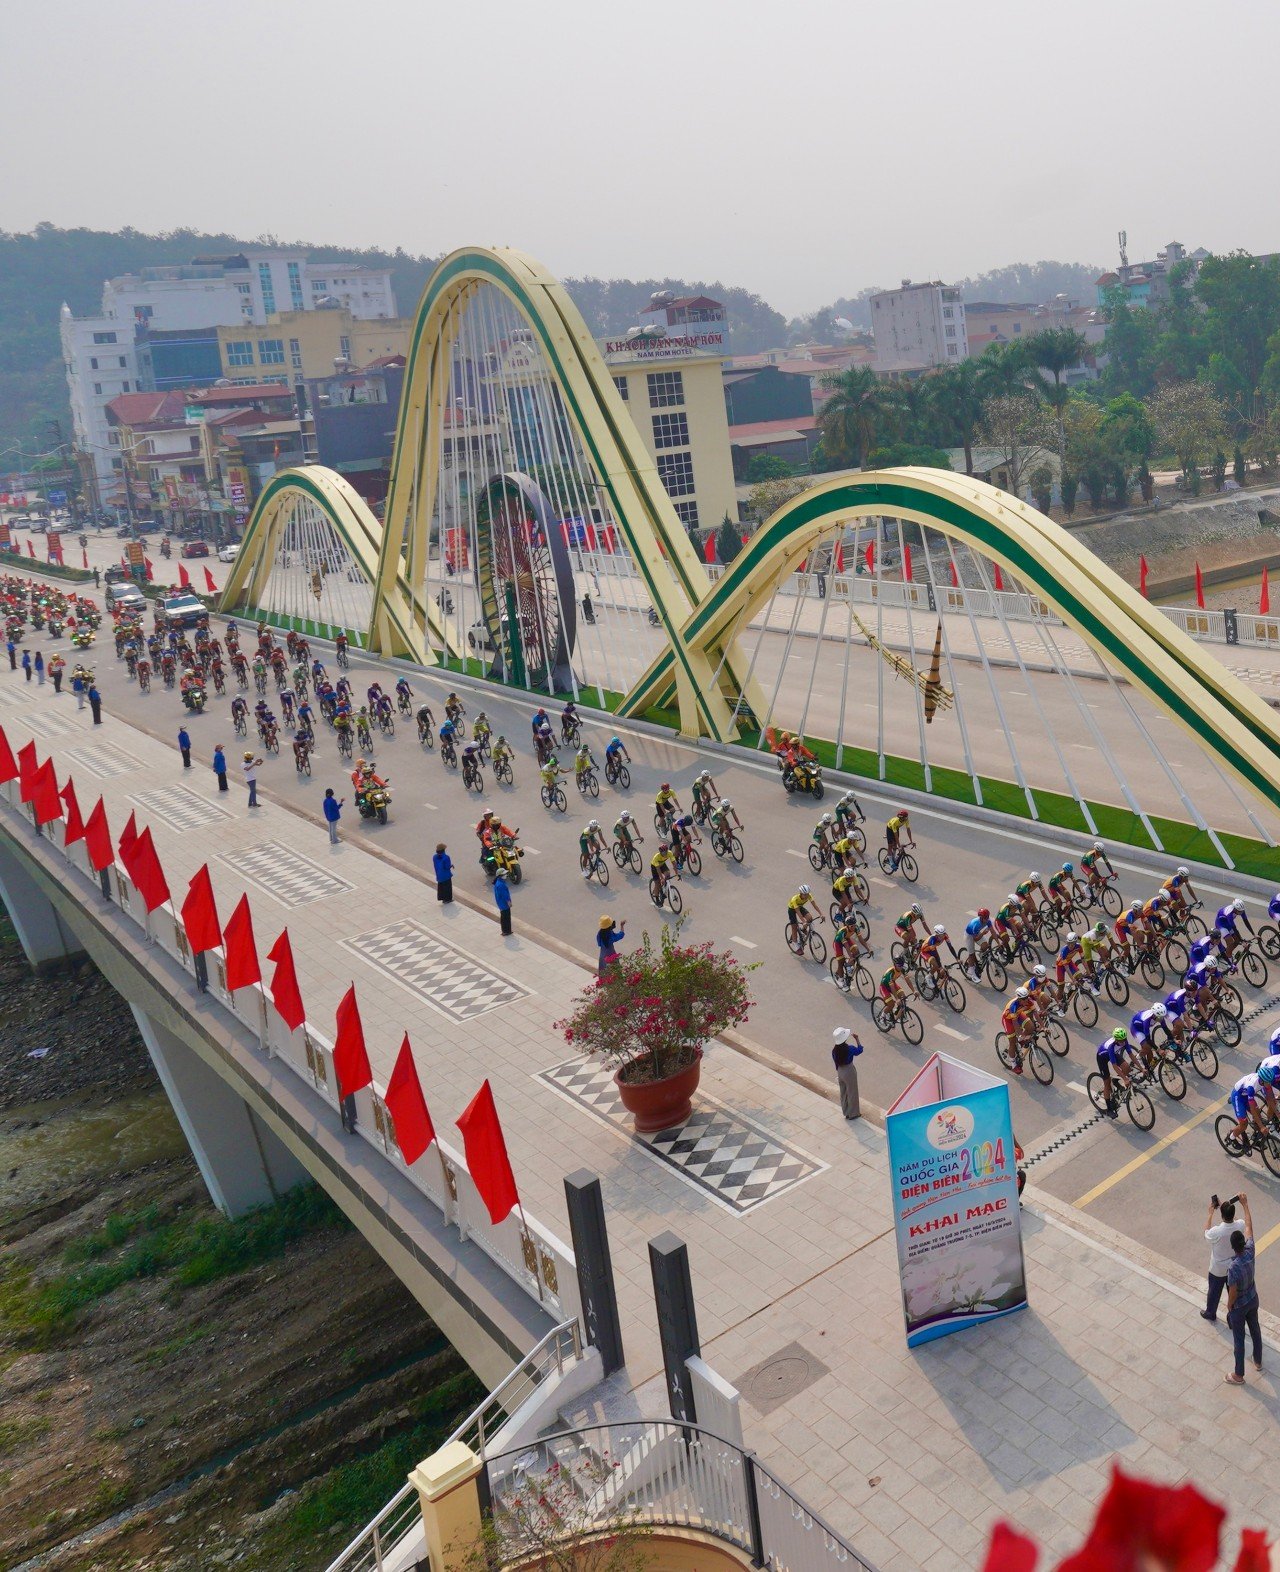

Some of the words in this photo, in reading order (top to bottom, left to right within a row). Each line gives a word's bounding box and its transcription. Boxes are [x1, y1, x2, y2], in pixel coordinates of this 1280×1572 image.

[606, 338, 647, 352] KHÁCH
[900, 1168, 935, 1185] QUỐC
[939, 1162, 959, 1174] GIA
[901, 1182, 930, 1199] ĐIỆN
[932, 1173, 960, 1190] BIÊN
[960, 1138, 1006, 1182] 2024
[922, 1157, 935, 1167] DU
[909, 1213, 959, 1238] KHAI
[966, 1198, 1008, 1220] MẠC
